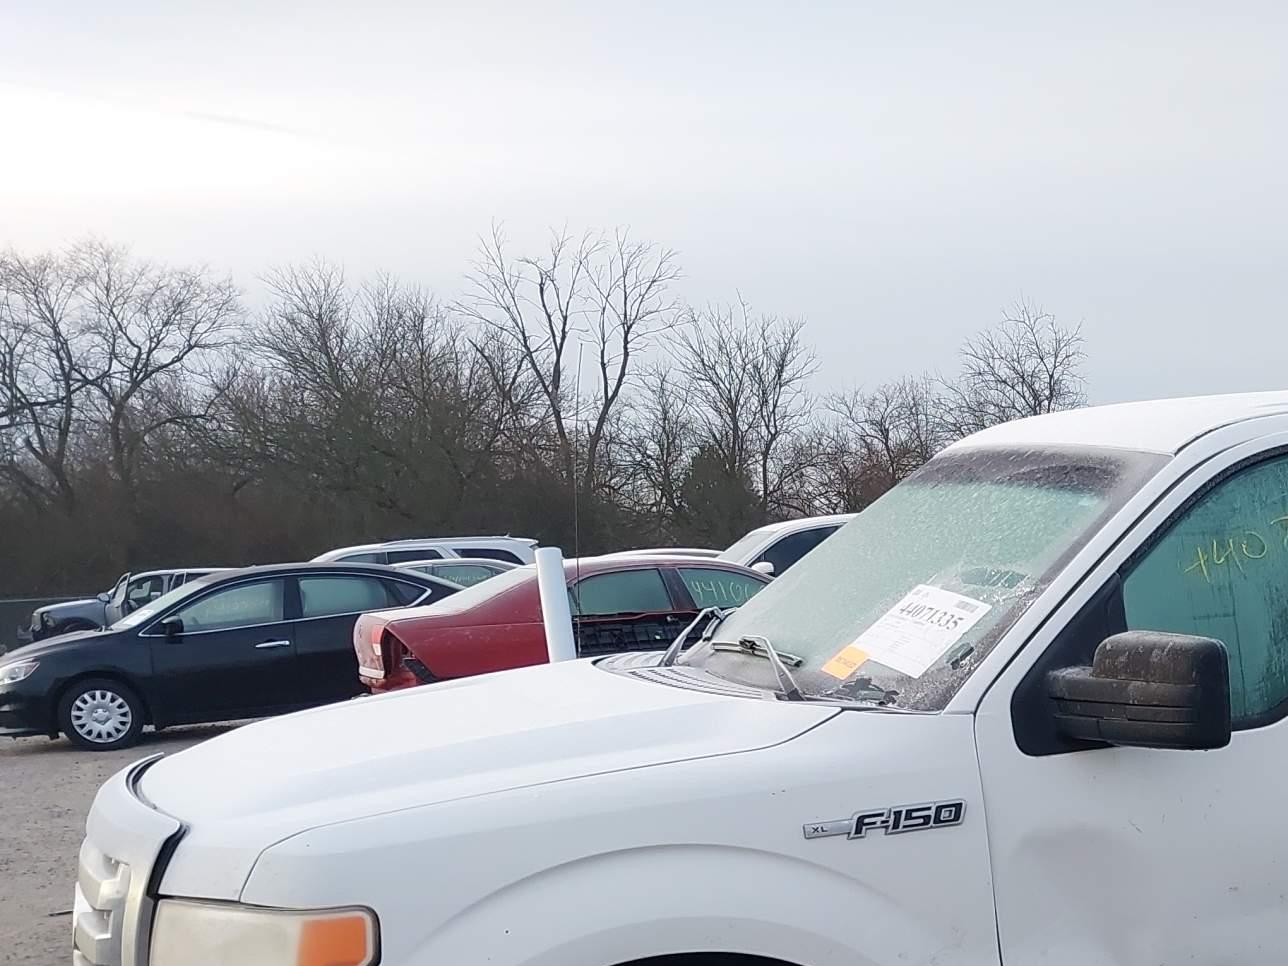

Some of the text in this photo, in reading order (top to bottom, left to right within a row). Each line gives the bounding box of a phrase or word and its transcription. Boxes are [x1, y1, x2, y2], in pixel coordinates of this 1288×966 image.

[899, 601, 964, 631] 44071335
[811, 801, 965, 837] XL F-150
